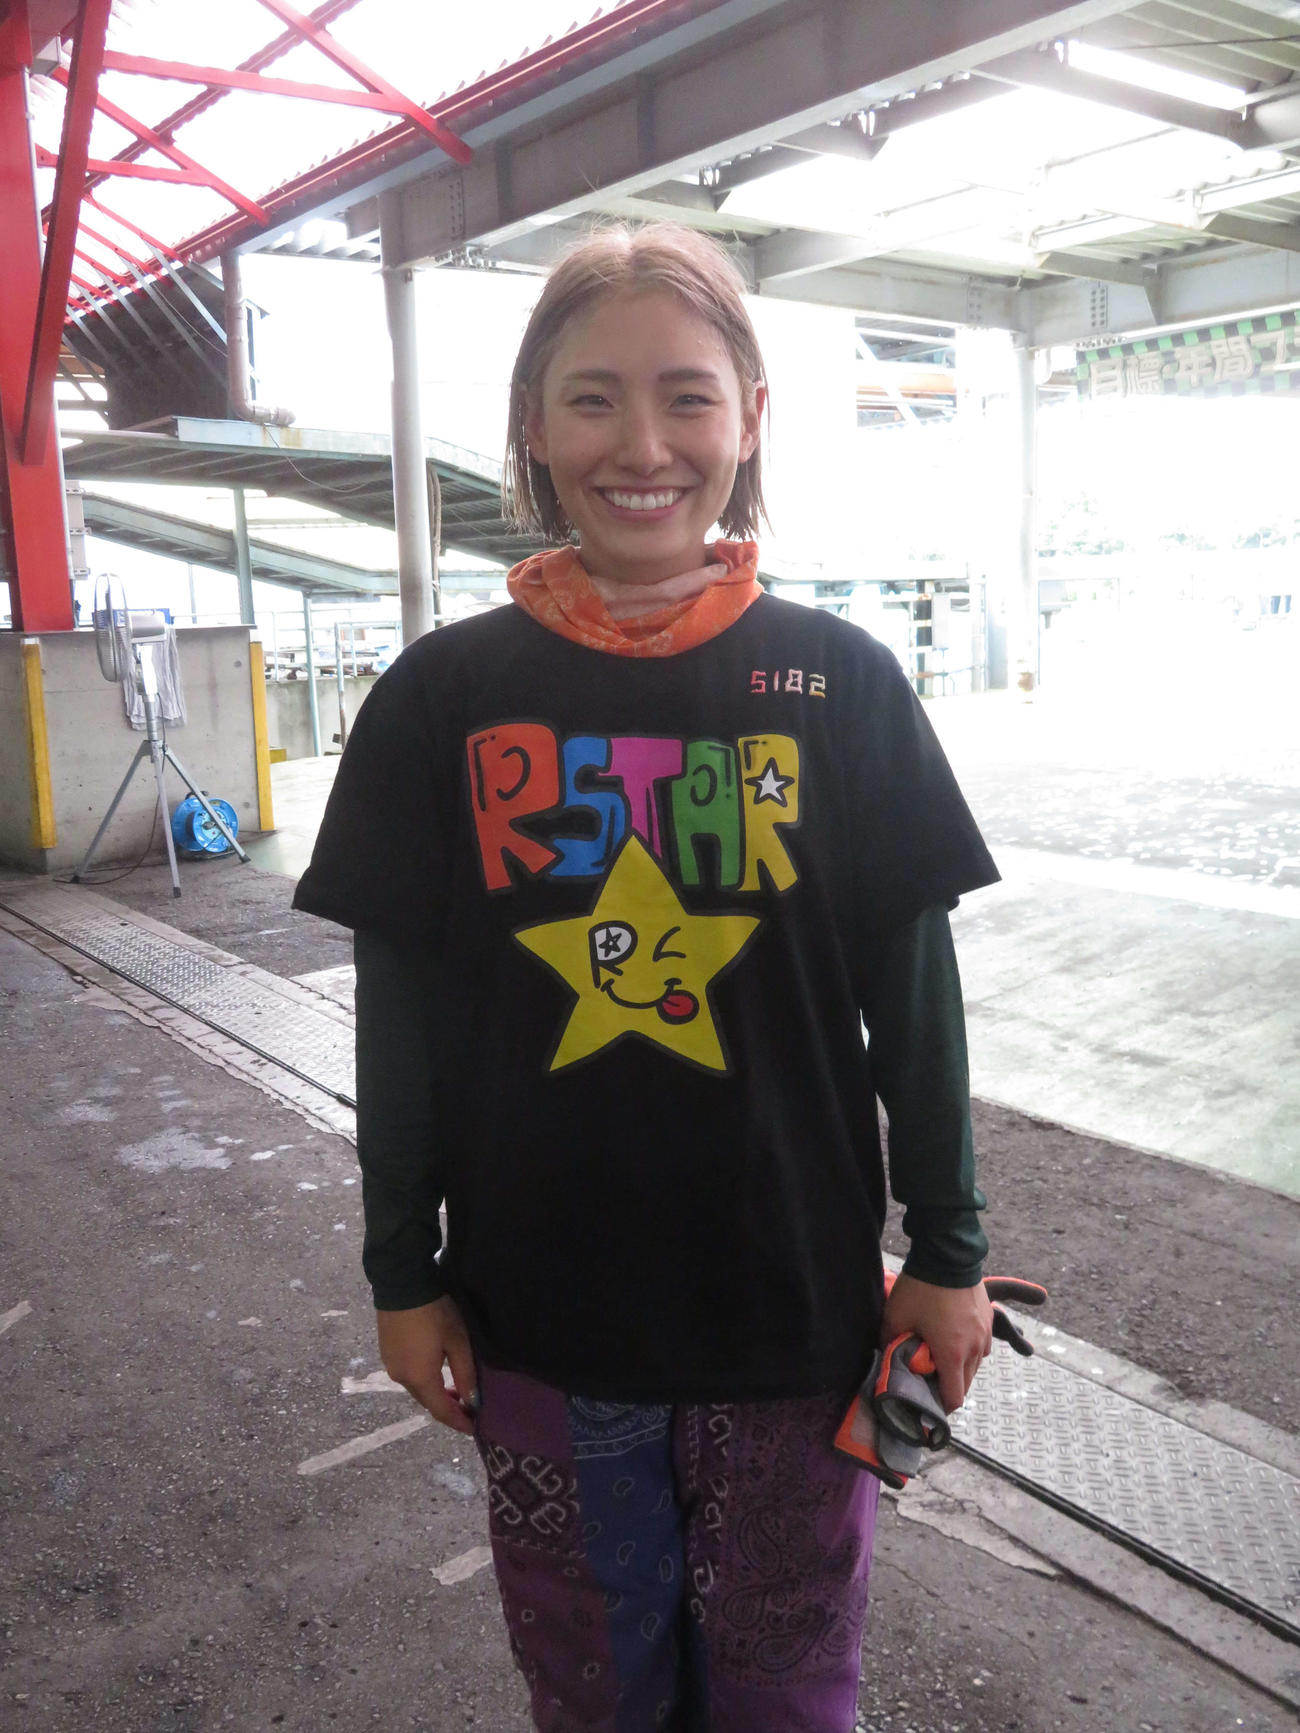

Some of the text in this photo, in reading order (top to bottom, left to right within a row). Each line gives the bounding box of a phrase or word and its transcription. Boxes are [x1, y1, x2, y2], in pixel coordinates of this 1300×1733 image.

[1089, 325, 1300, 400] 目標・年間フ
[750, 668, 827, 699] 5182
[466, 722, 800, 893] RSTAR
